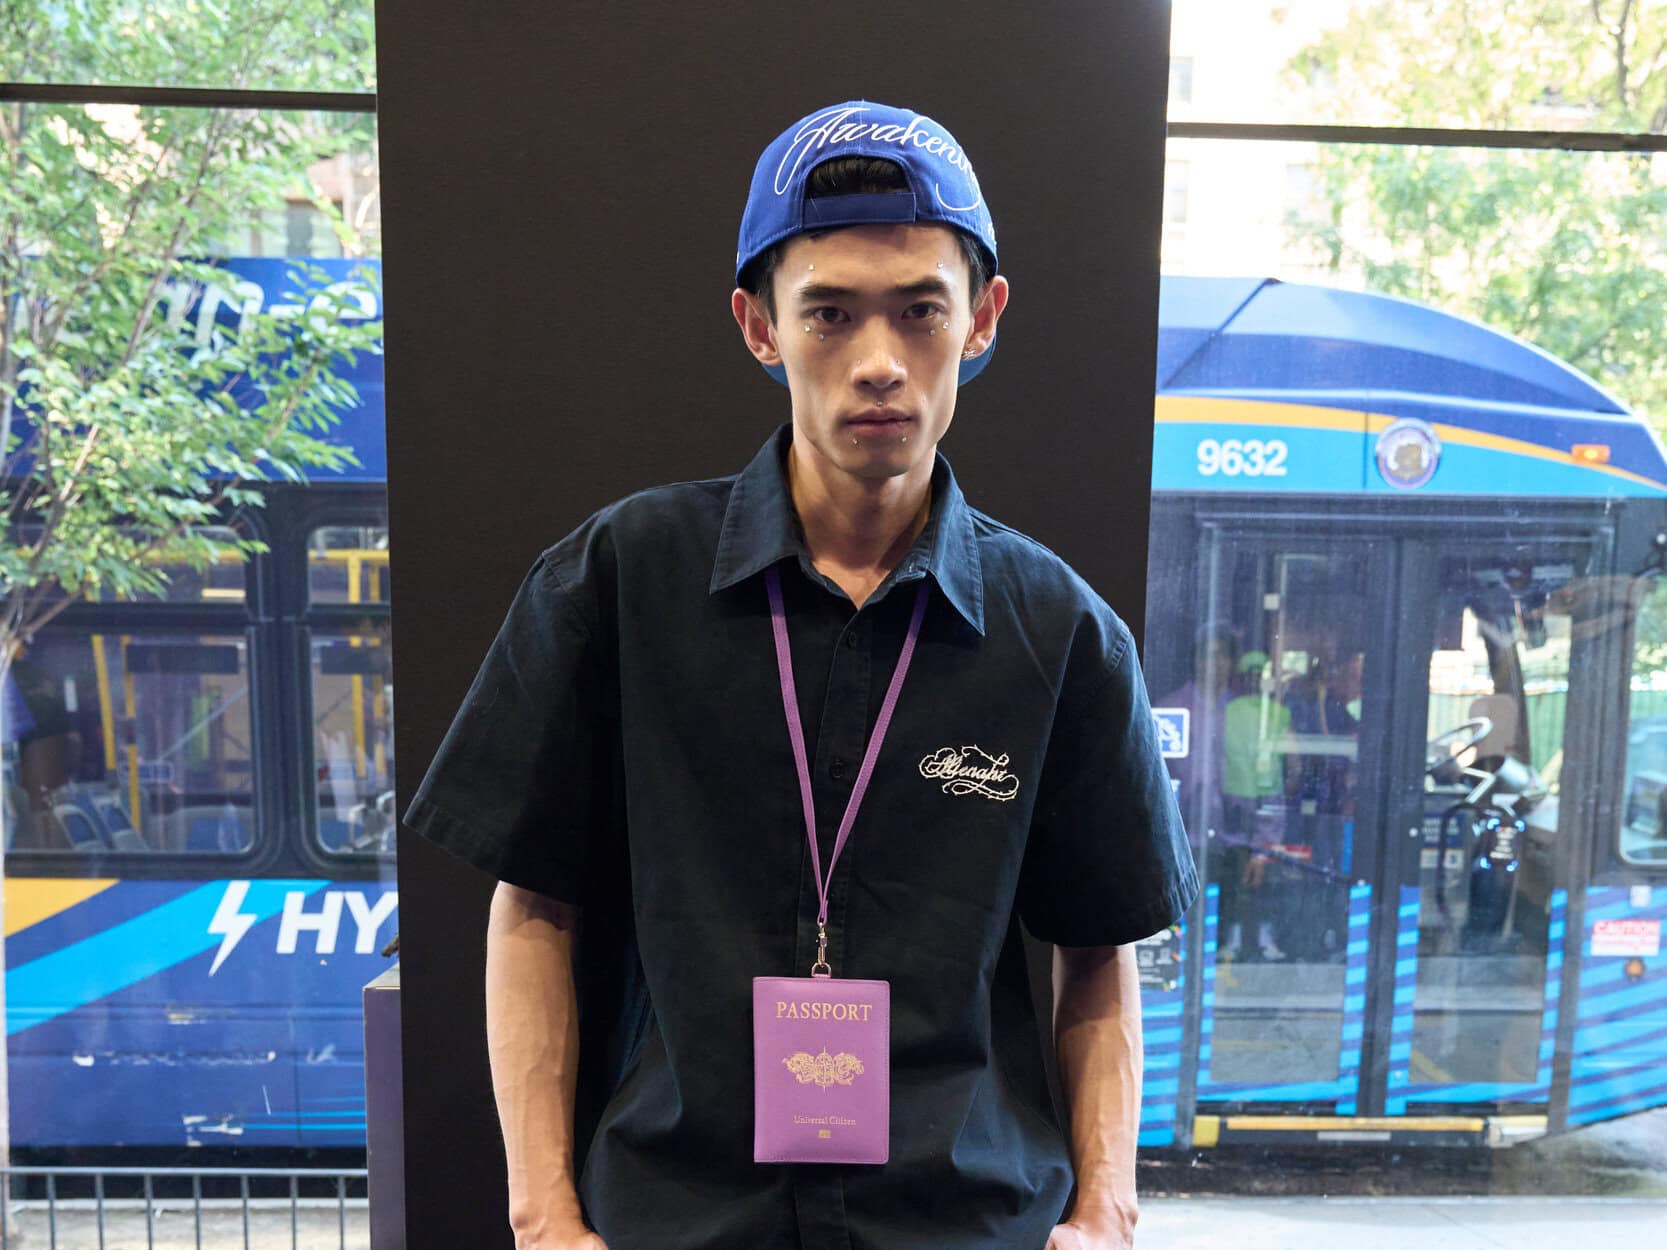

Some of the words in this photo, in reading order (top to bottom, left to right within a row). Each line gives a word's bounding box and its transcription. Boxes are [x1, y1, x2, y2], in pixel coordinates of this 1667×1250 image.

[1197, 439, 1288, 477] 9632
[276, 891, 399, 954] HY
[775, 1001, 873, 1022] PASSPORT
[794, 1115, 828, 1125] Universal
